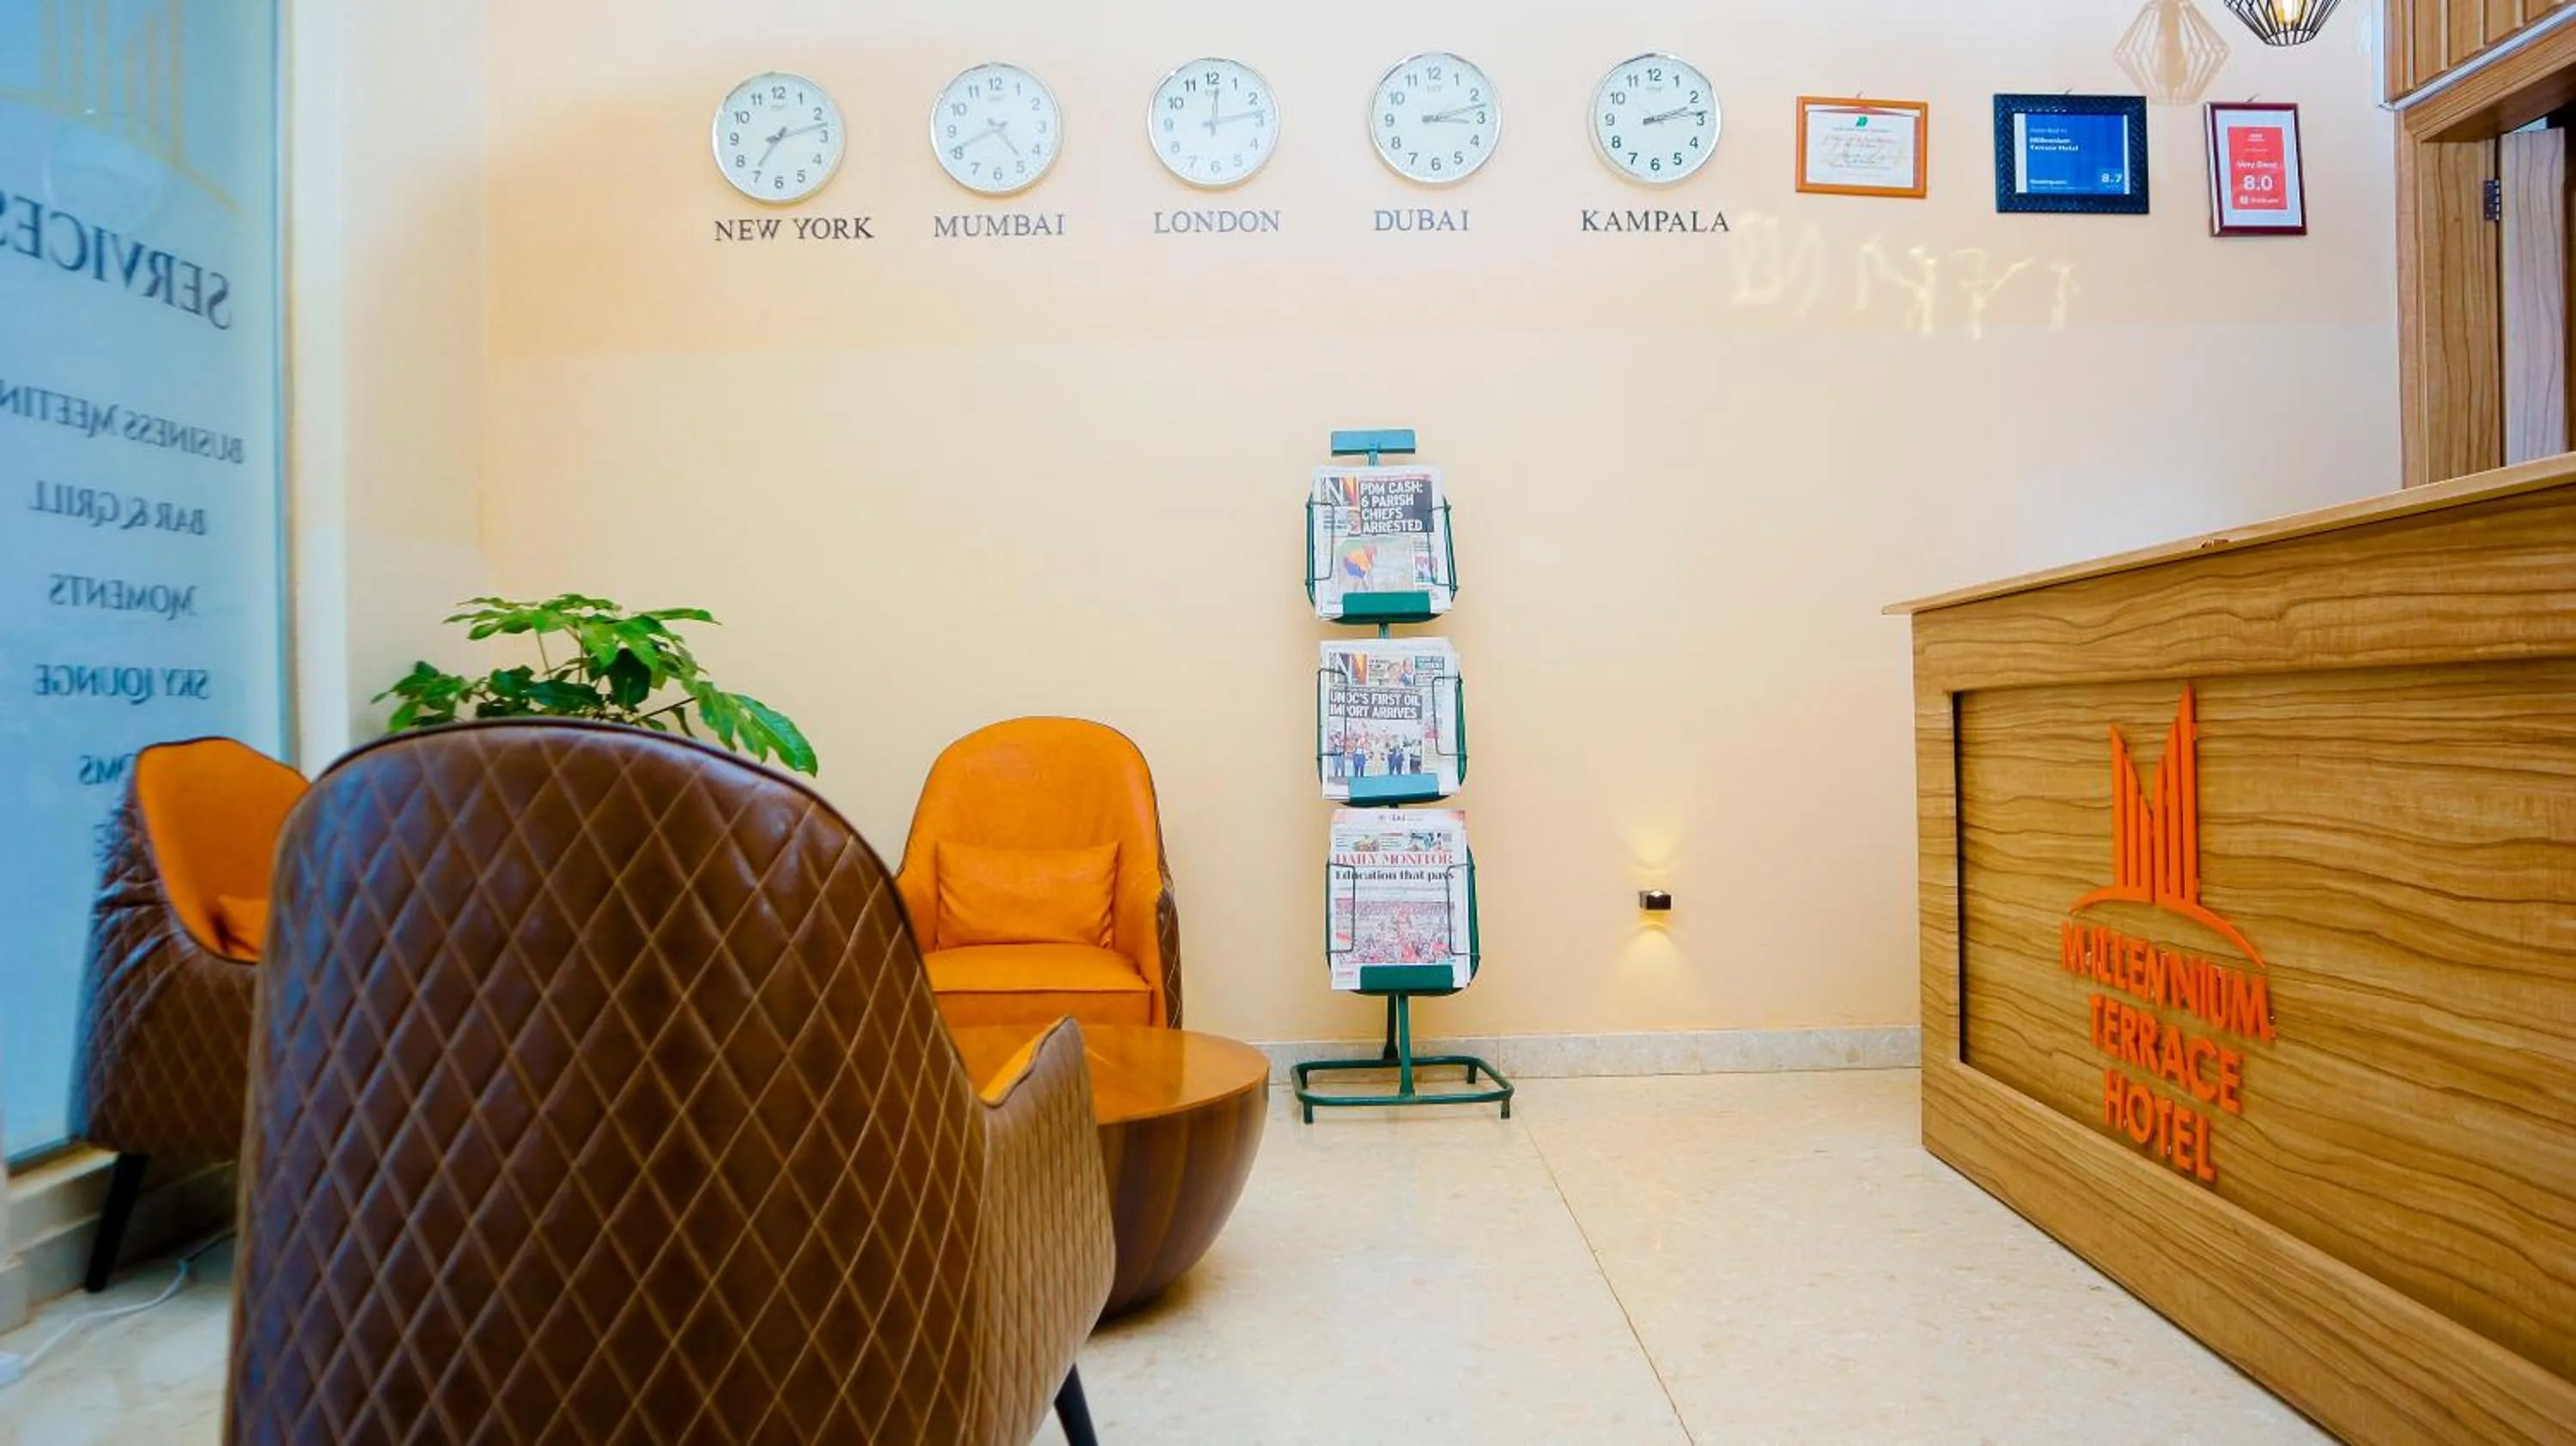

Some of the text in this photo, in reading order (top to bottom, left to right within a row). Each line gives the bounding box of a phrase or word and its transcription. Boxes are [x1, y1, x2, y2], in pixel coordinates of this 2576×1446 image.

[1206, 72, 1219, 84] 12
[1406, 74, 1417, 86] 11
[1426, 67, 1441, 80] 12
[1454, 74, 1459, 85] 1
[1647, 69, 1662, 82] 12
[988, 78, 1003, 90] 12
[1184, 80, 1196, 92] 11
[1232, 77, 1237, 89] 1
[1626, 75, 1638, 88] 11
[1674, 76, 1680, 88] 1
[772, 87, 786, 100] 12
[969, 86, 979, 98] 11
[1016, 83, 1021, 95] 1
[1470, 88, 1479, 101] 2
[751, 94, 762, 105] 11
[798, 93, 803, 105] 1
[1249, 92, 1258, 105] 2
[1389, 92, 1405, 105] 10
[1610, 92, 1625, 105] 10
[1690, 90, 1699, 103] 2
[951, 103, 967, 116] 10
[1031, 98, 1041, 111] 2
[1169, 97, 1183, 110] 10
[734, 111, 750, 124] 10
[814, 107, 823, 120] 2
[1255, 112, 1264, 127] 3
[1477, 111, 1485, 124] 3
[1606, 113, 1614, 125] 9
[1696, 112, 1704, 125] 3
[1037, 121, 1046, 133] 3
[1164, 118, 1174, 131] 9
[1385, 114, 1394, 127] 9
[820, 131, 828, 143] 3
[948, 125, 957, 137] 9
[731, 133, 739, 146] 9
[1250, 138, 1258, 150] 4
[1391, 136, 1401, 149] 8
[1470, 135, 1479, 147] 4
[1612, 136, 1621, 149] 8
[1690, 137, 1698, 149] 4
[953, 147, 963, 160] 8
[1033, 144, 1040, 155] 4
[1171, 141, 1180, 154] 8
[736, 155, 745, 167] 8
[813, 155, 822, 164] 4
[1188, 156, 1197, 168] 7
[1233, 155, 1242, 167] 5
[1408, 153, 1419, 165] 7
[1455, 151, 1463, 164] 5
[1628, 153, 1637, 165] 7
[1673, 153, 1682, 165] 5
[970, 162, 981, 175] 7
[1017, 161, 1024, 173] 5
[1211, 161, 1220, 173] 6
[1431, 158, 1441, 171] 6
[1650, 158, 1661, 171] 6
[752, 171, 761, 183] 7
[797, 170, 805, 183] 5
[993, 167, 1003, 181] 6
[2101, 173, 2122, 183] 8.7
[775, 177, 783, 189] 6
[2244, 175, 2273, 191] 8.0
[934, 214, 1065, 237] MUMBAI
[1153, 210, 1281, 234] LONDON
[1374, 209, 1471, 231] DUBAI
[1581, 210, 1730, 233] KAMPALA
[714, 217, 874, 241] NEW YORK
[1361, 481, 1423, 495] PDM CASH:
[1361, 495, 1414, 507] 6 PARISH
[1362, 507, 1403, 520] CHIEFS
[1363, 519, 1423, 533] ARRESTED
[1372, 693, 1401, 705] FIRST
[1404, 695, 1420, 707] OIL
[1372, 707, 1418, 719] ARRIVES
[1335, 854, 1453, 865] DAILY MONITOR
[1400, 870, 1425, 880] that
[1428, 872, 1455, 882] pays
[2061, 920, 2271, 1043] MILLENNIUM
[2087, 993, 2243, 1115] TERRACE
[2104, 1069, 2216, 1182] HOTEL
